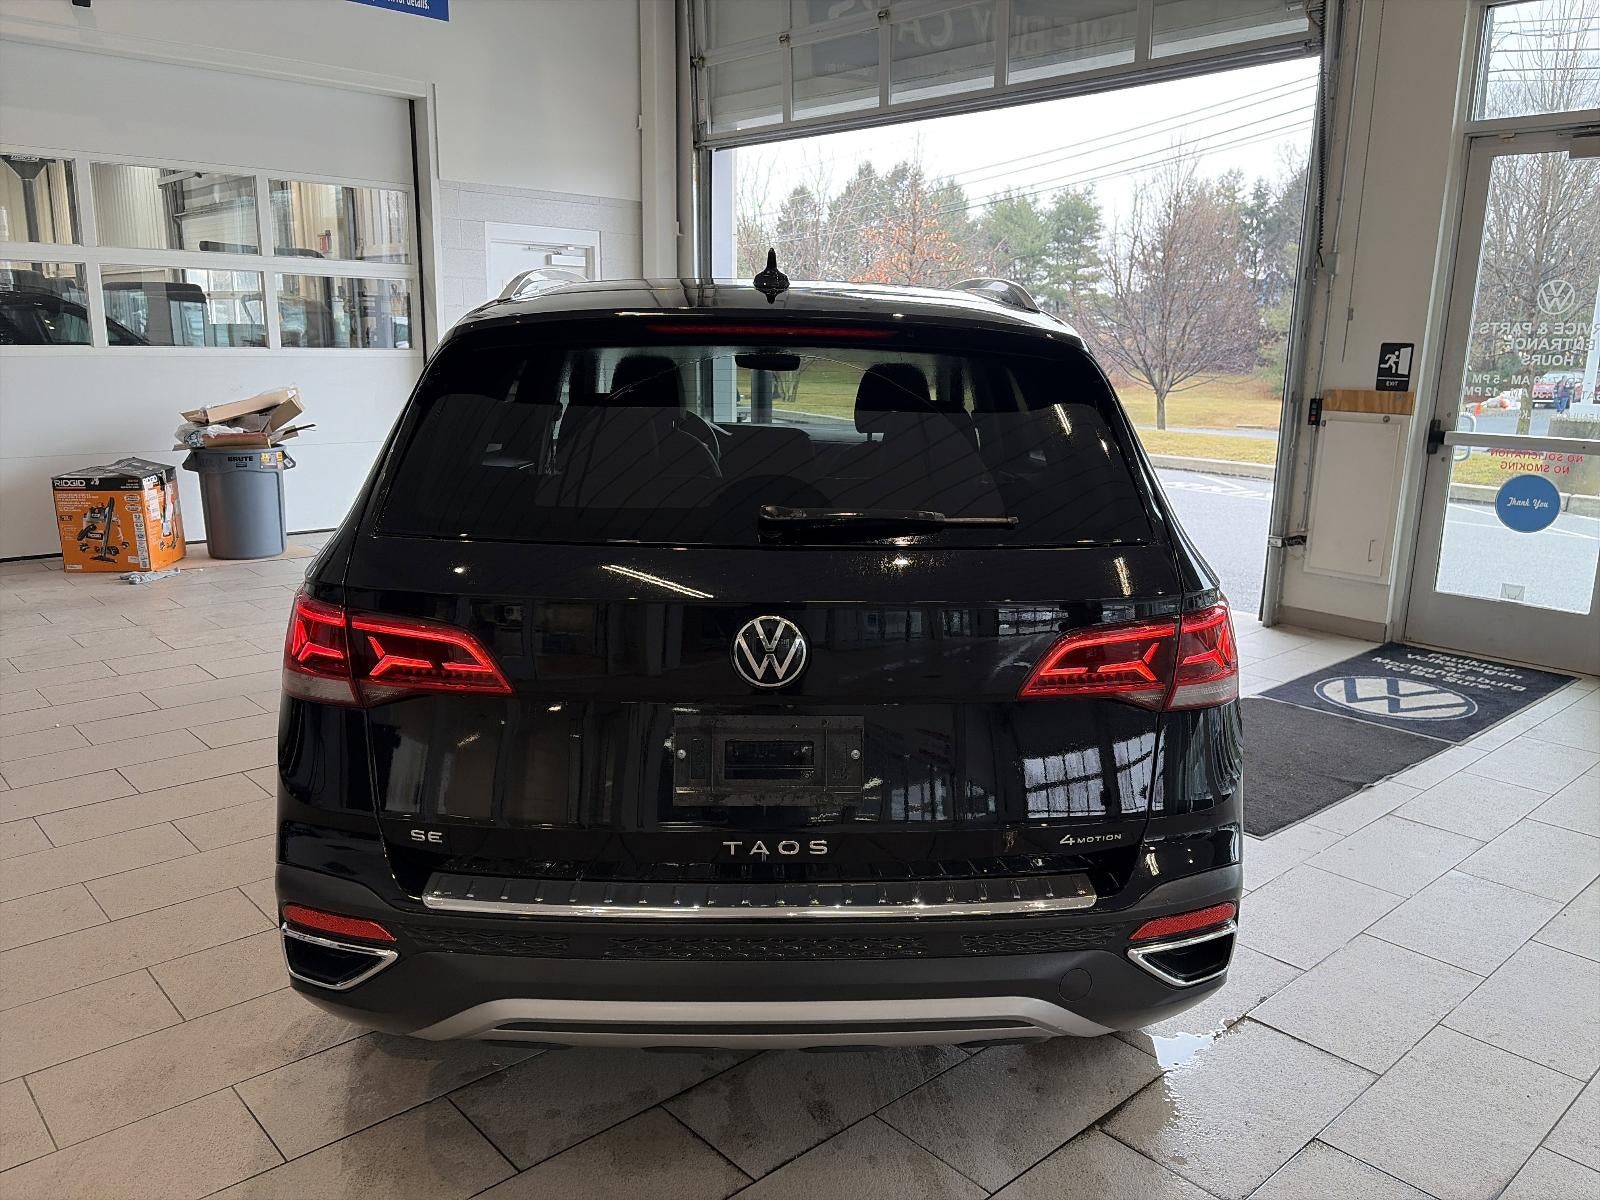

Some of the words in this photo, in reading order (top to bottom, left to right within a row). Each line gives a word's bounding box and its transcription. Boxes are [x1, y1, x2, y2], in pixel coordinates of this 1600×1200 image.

[53, 479, 86, 487] RIDGID
[1507, 496, 1530, 507] Thank
[1532, 498, 1549, 510] You
[1384, 664, 1405, 672] To
[1410, 669, 1438, 679] Be
[1407, 653, 1524, 679] Volkswagen
[1371, 656, 1527, 692] Mechanicsburg
[410, 829, 443, 843] SE
[1059, 833, 1122, 846] 4MOTION
[722, 839, 828, 855] TAOS
